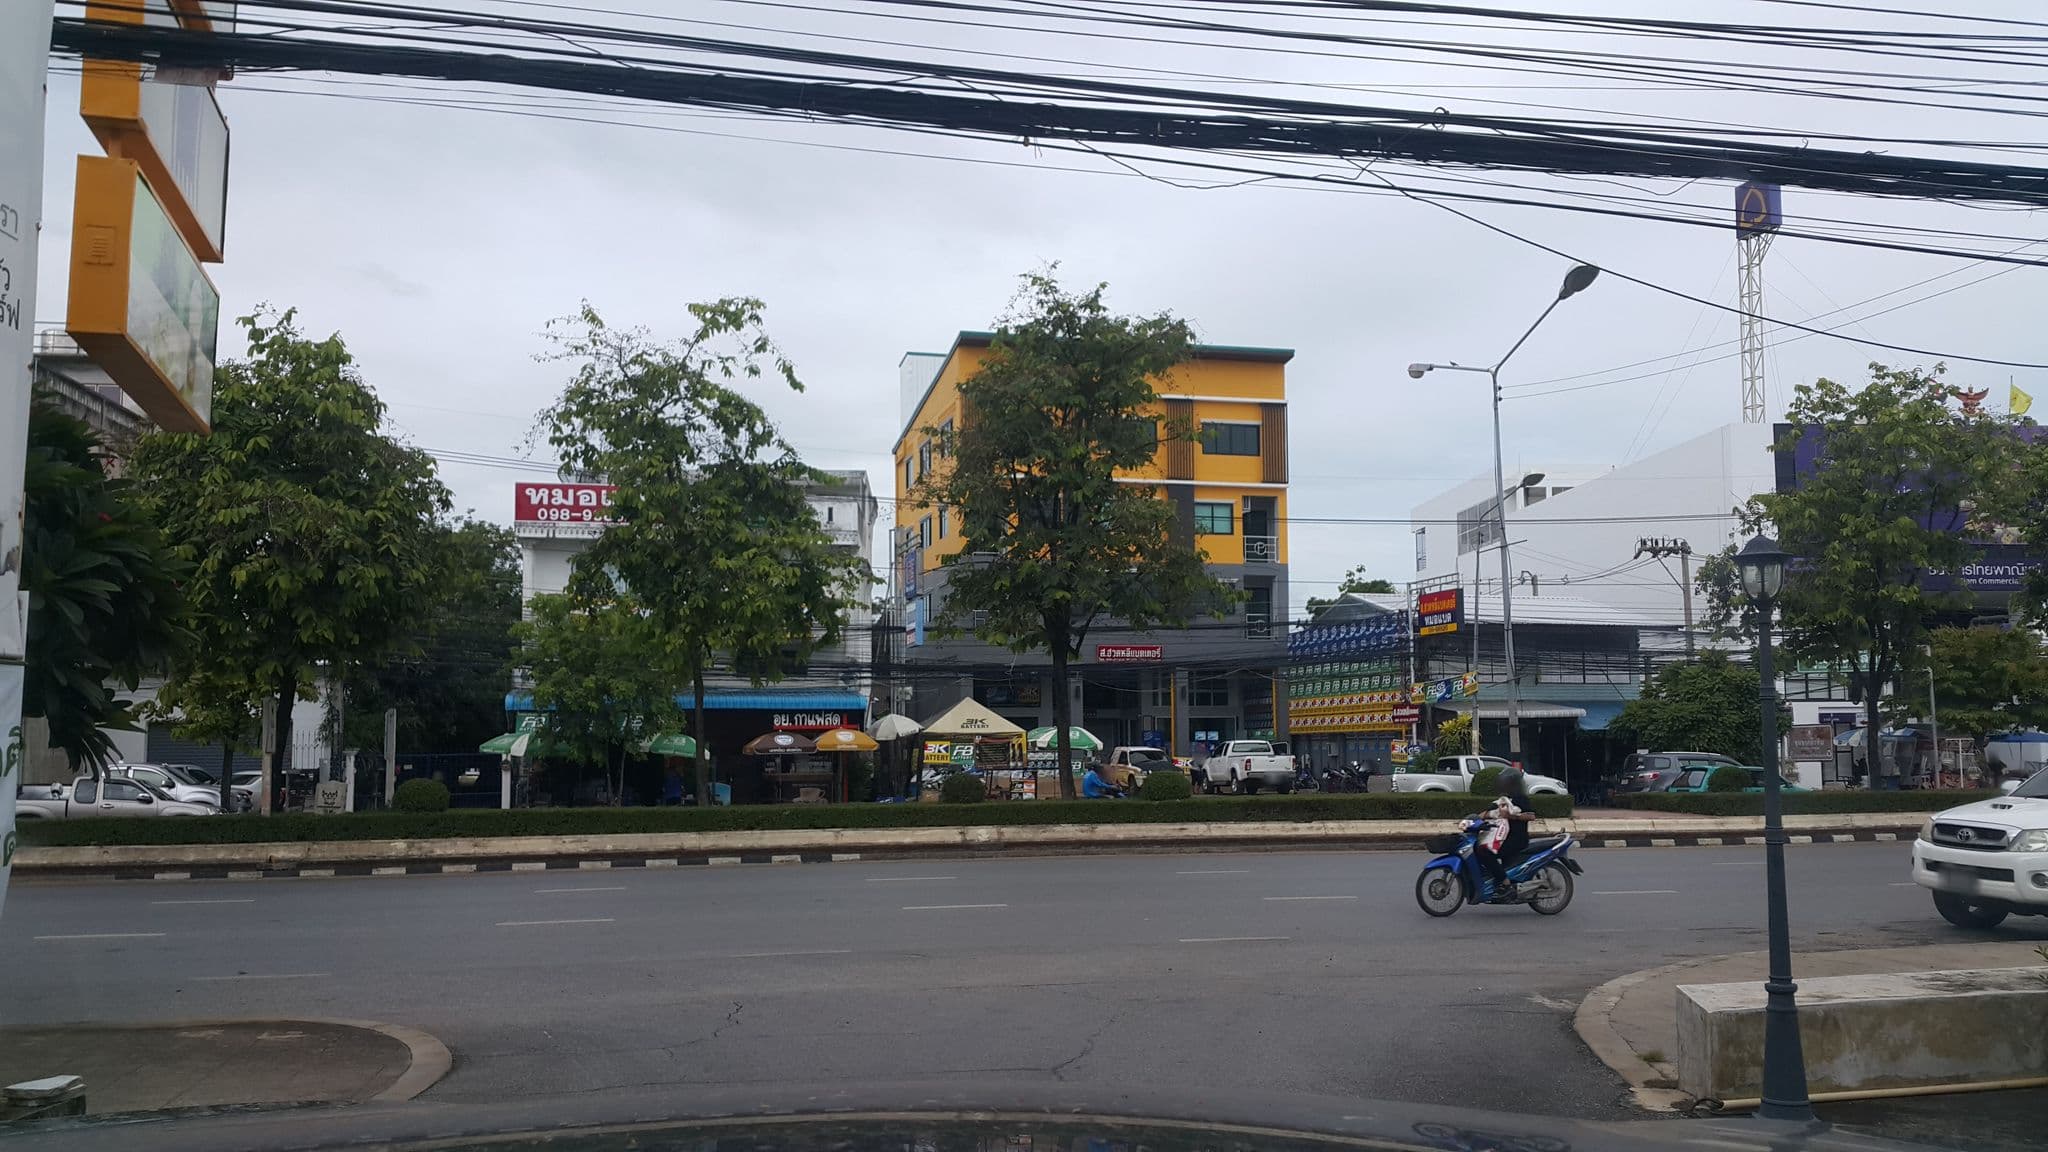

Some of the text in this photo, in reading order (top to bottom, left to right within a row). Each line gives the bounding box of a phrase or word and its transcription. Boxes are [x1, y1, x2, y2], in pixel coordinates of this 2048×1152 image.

[1978, 577, 2022, 585] Commercia
[924, 743, 949, 754] 3K
[953, 745, 974, 756] FB
